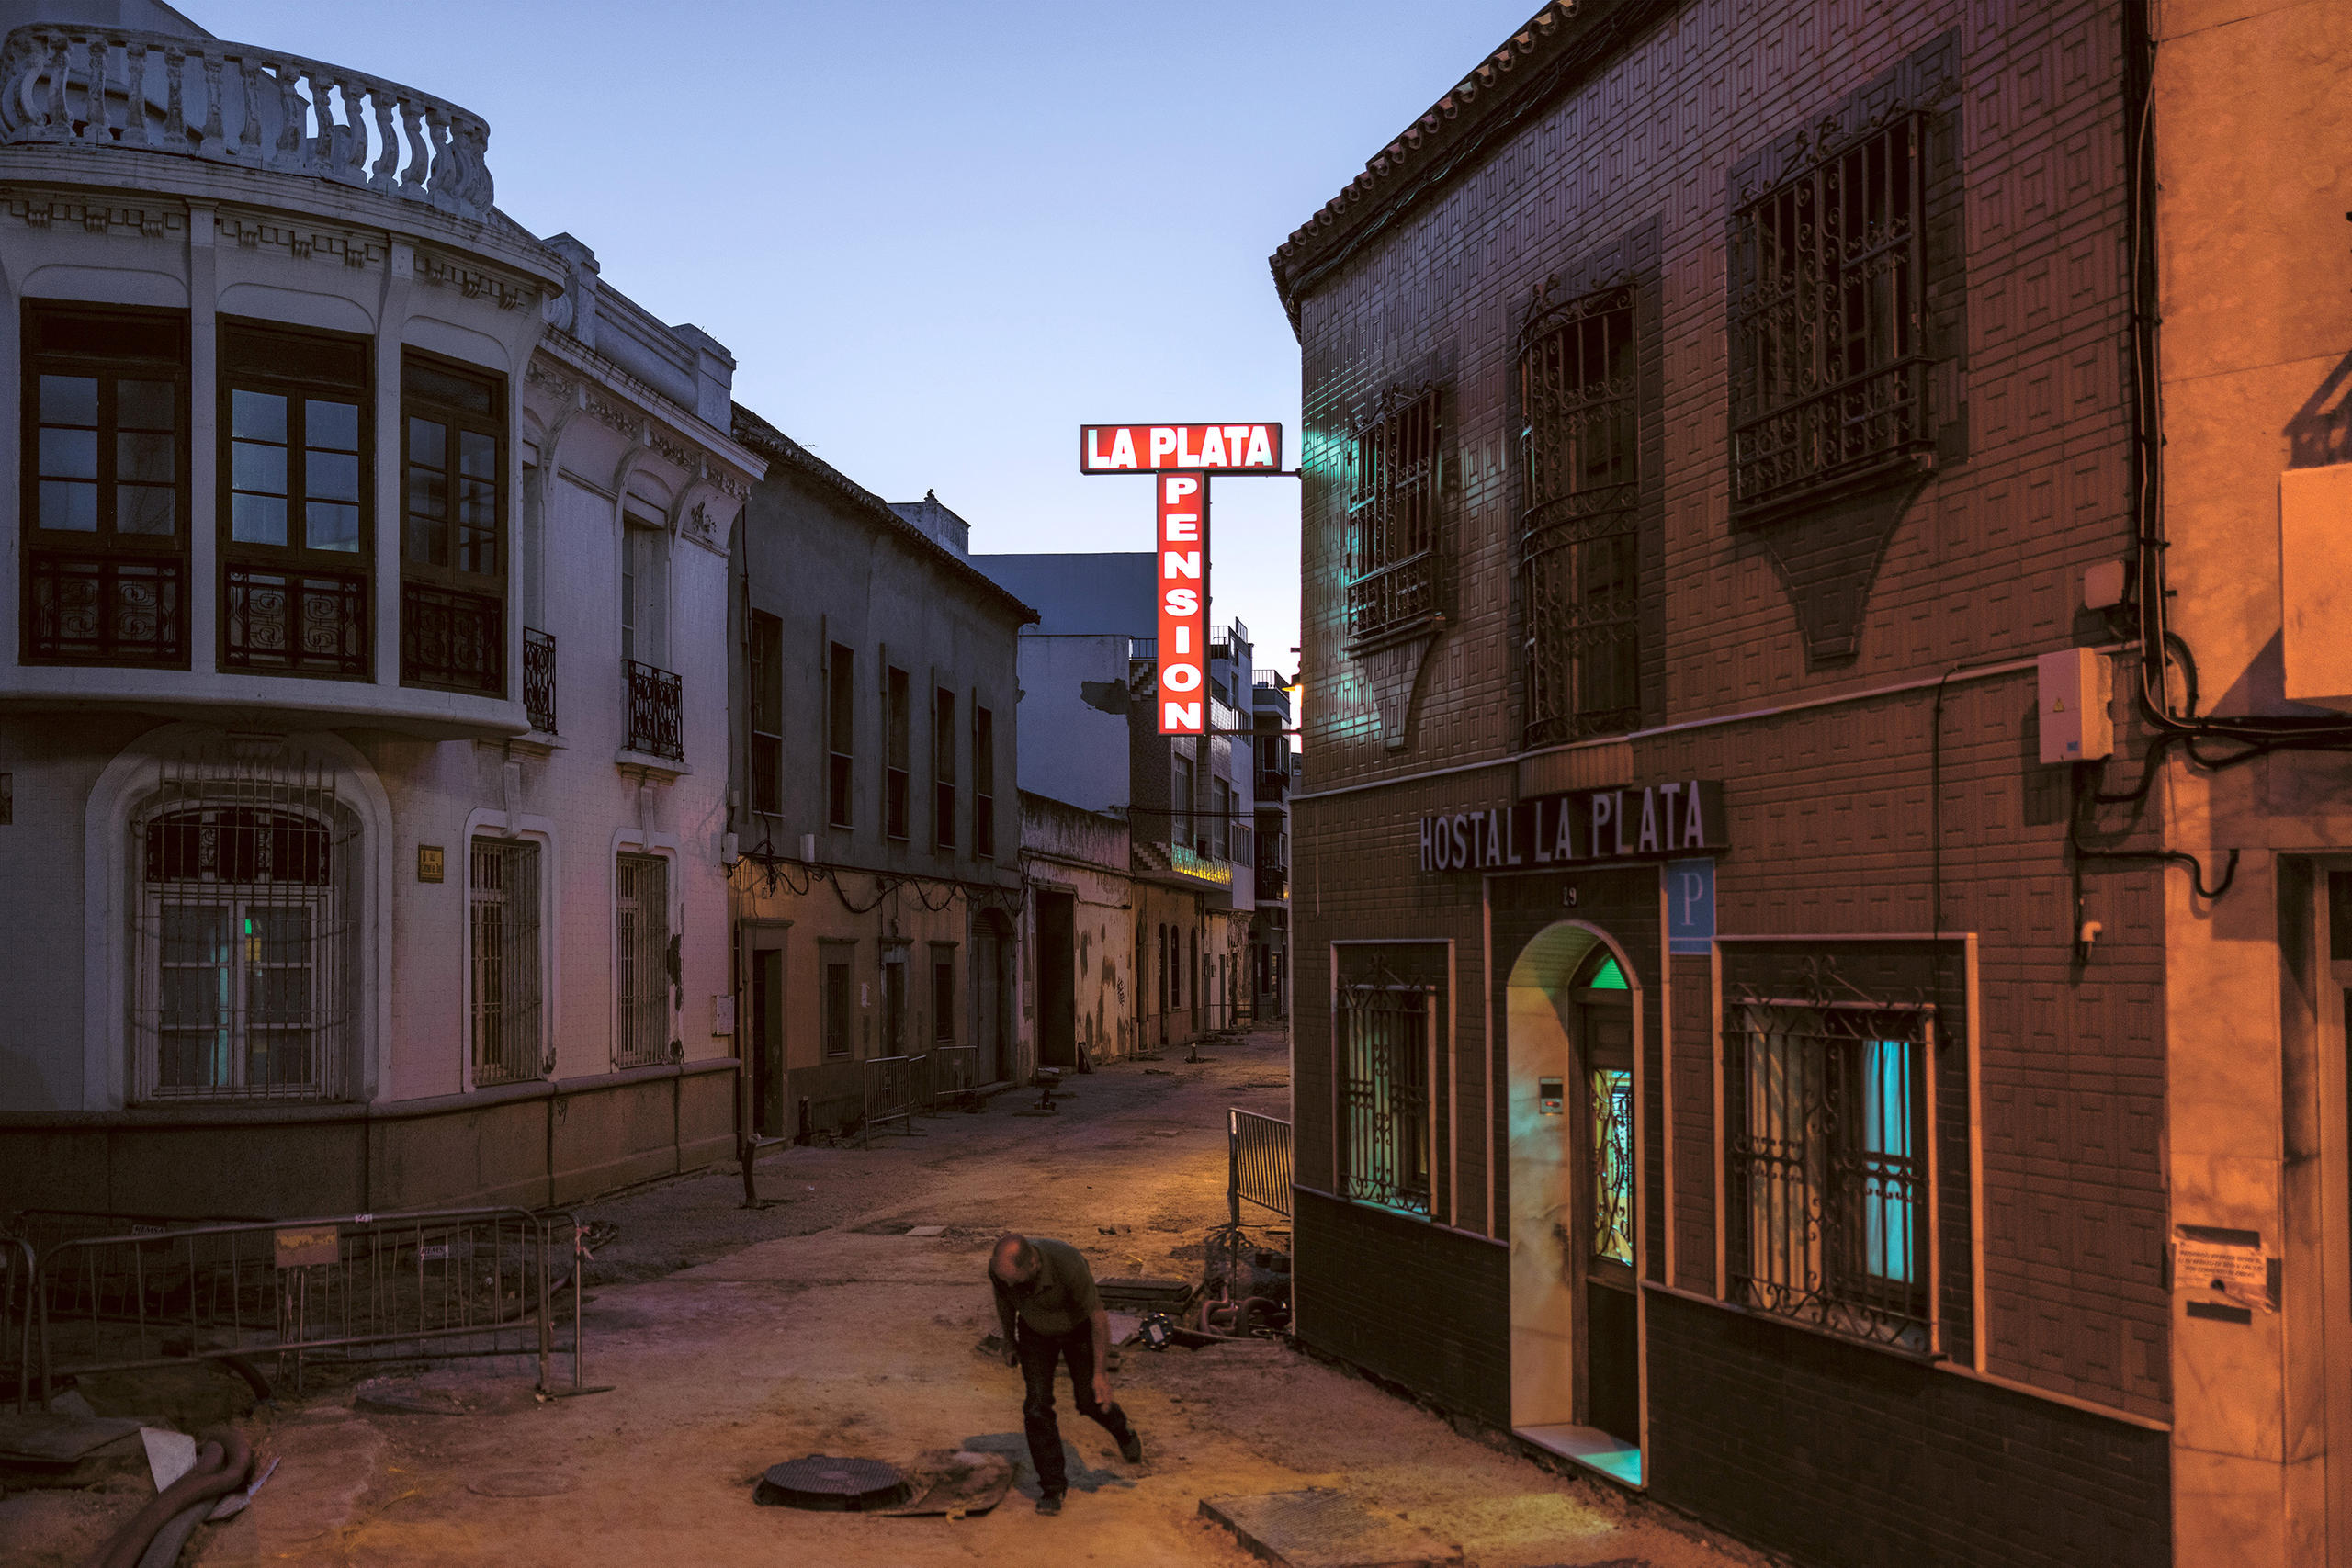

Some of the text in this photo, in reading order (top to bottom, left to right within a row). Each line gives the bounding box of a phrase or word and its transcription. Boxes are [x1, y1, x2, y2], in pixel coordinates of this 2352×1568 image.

[1087, 425, 1274, 468] LA PLATA
[1162, 477, 1202, 730] PENSION
[1420, 779, 1705, 872] HOSTAL LA PLATA
[1680, 873, 1703, 926] P
